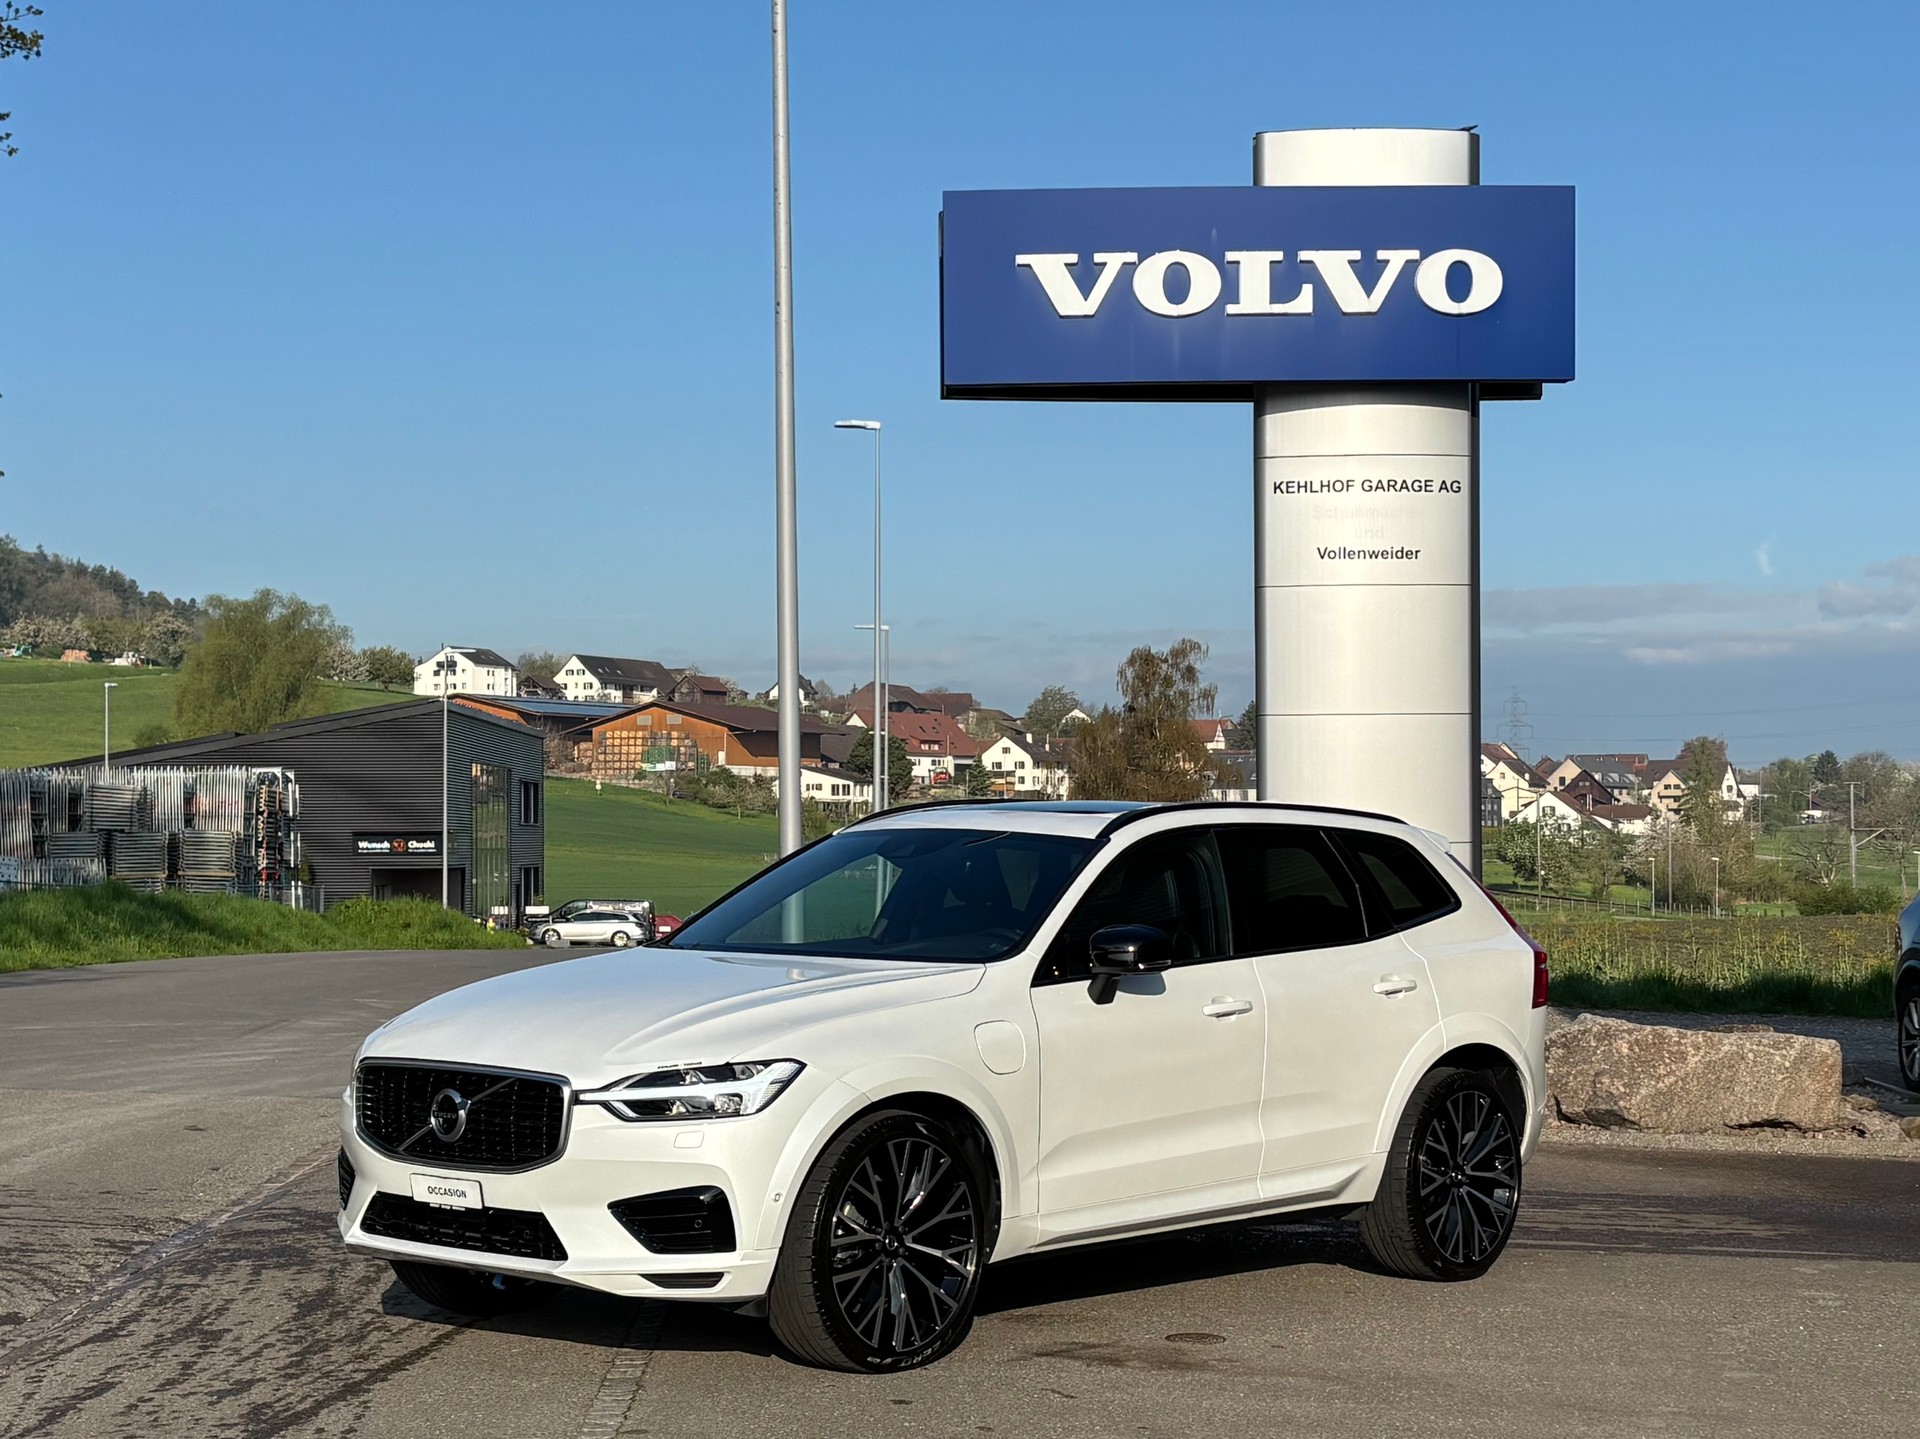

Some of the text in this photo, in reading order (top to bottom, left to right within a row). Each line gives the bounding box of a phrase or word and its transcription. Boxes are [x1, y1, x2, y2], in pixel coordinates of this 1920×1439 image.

[1015, 248, 1503, 318] VOLVO
[1273, 479, 1462, 494] KEHLHOF GARAGE AG
[1317, 547, 1421, 560] Vollenweider
[427, 1185, 467, 1199] OCCASION
